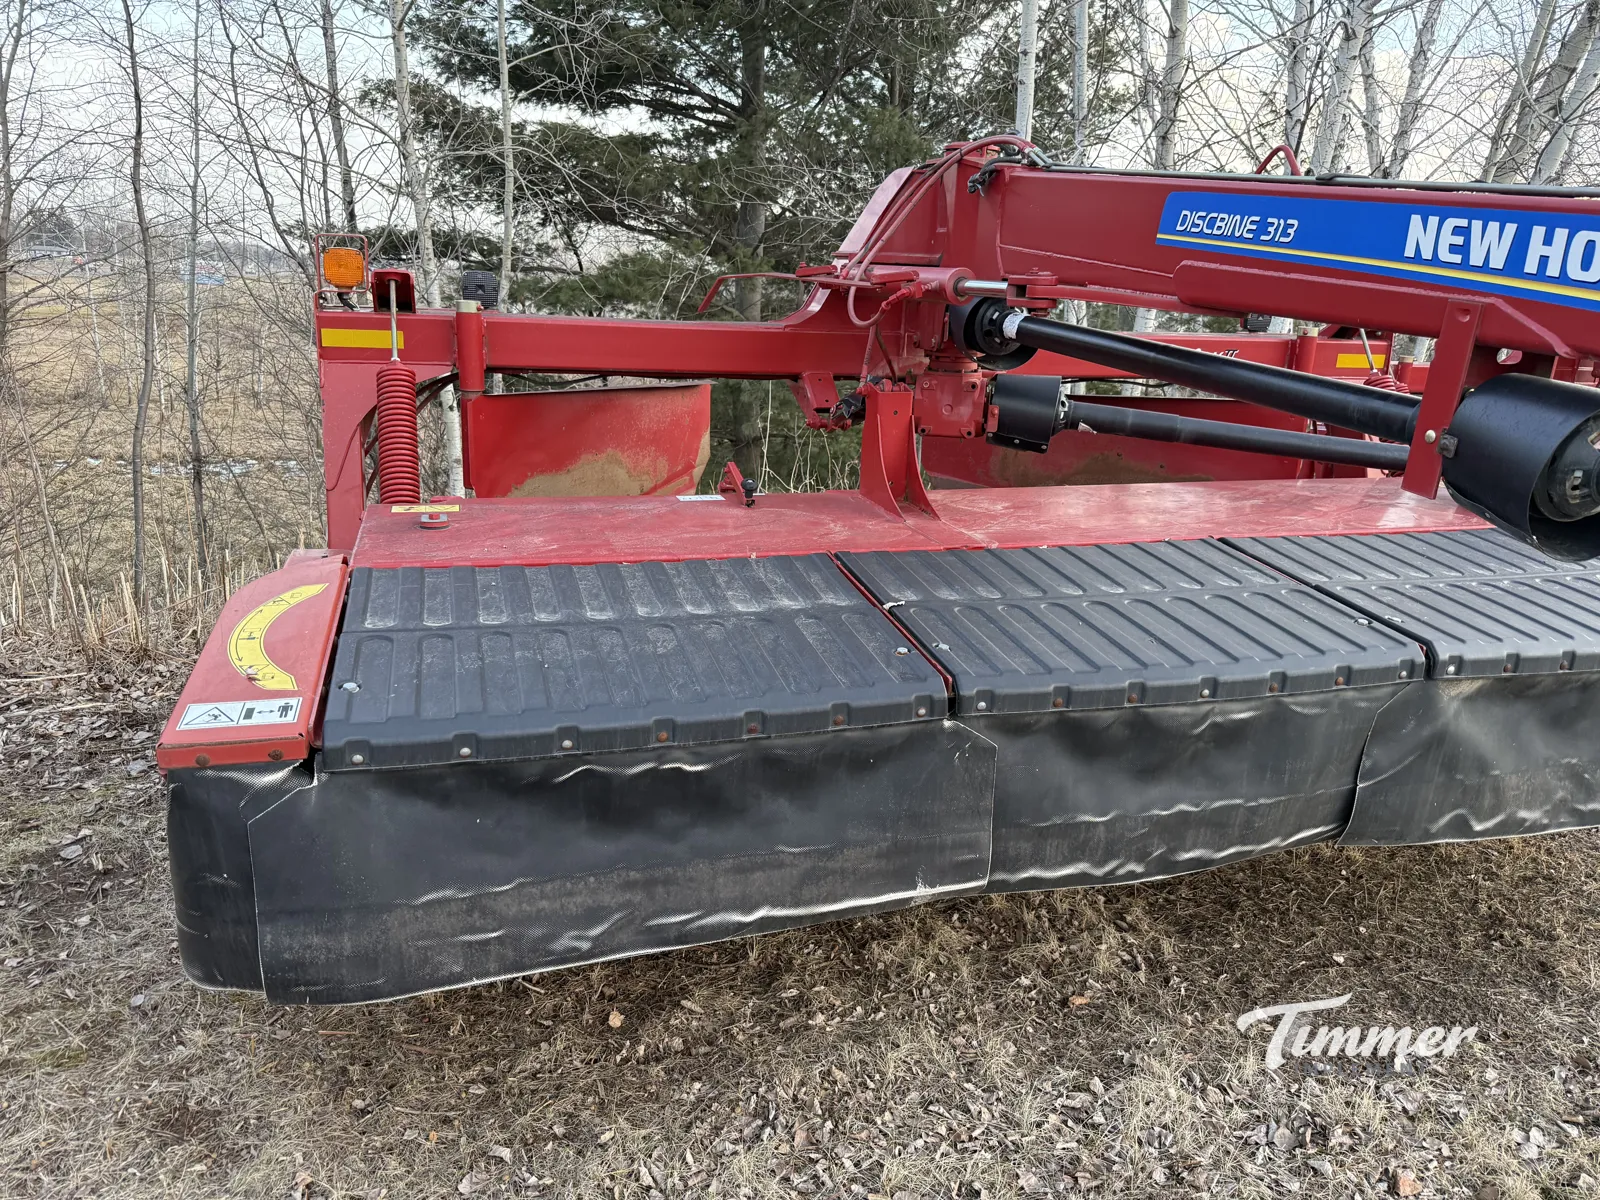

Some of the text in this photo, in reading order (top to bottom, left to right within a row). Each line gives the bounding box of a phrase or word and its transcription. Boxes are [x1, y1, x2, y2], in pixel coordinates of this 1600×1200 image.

[1176, 210, 1299, 243] DISCBINE 313
[1404, 214, 1600, 283] NEW HO
